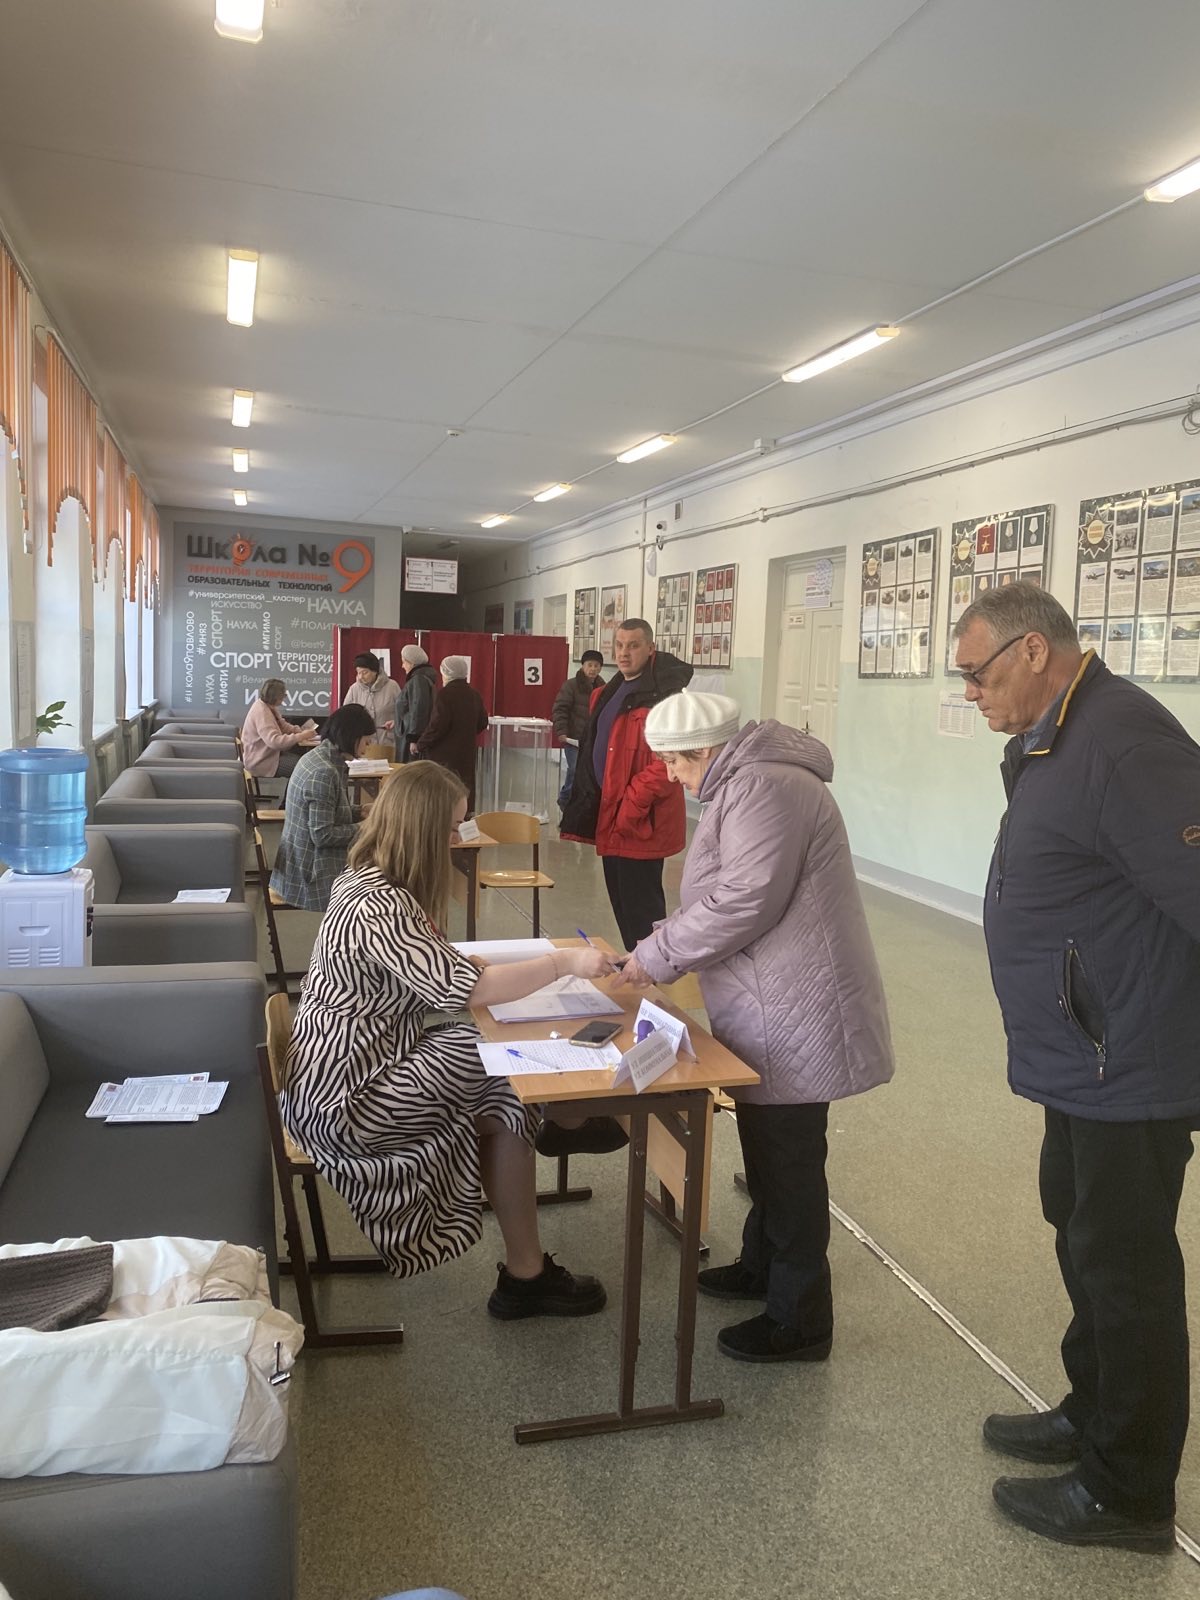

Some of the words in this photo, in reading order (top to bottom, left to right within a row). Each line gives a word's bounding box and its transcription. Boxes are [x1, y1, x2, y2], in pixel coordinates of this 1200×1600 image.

[187, 575, 270, 588] ОБРАЗОВАТЕЛЬНЫХ
[278, 581, 333, 592] ТЕХНОЛОГИЙ
[210, 600, 262, 610] ИСКУССТВО
[307, 597, 367, 616] НАУКА
[211, 609, 223, 649] СПОРТ
[226, 620, 258, 630] НАУКА
[210, 651, 273, 669] СПОРТ
[527, 666, 540, 683] 3
[205, 674, 215, 704] НАУКА
